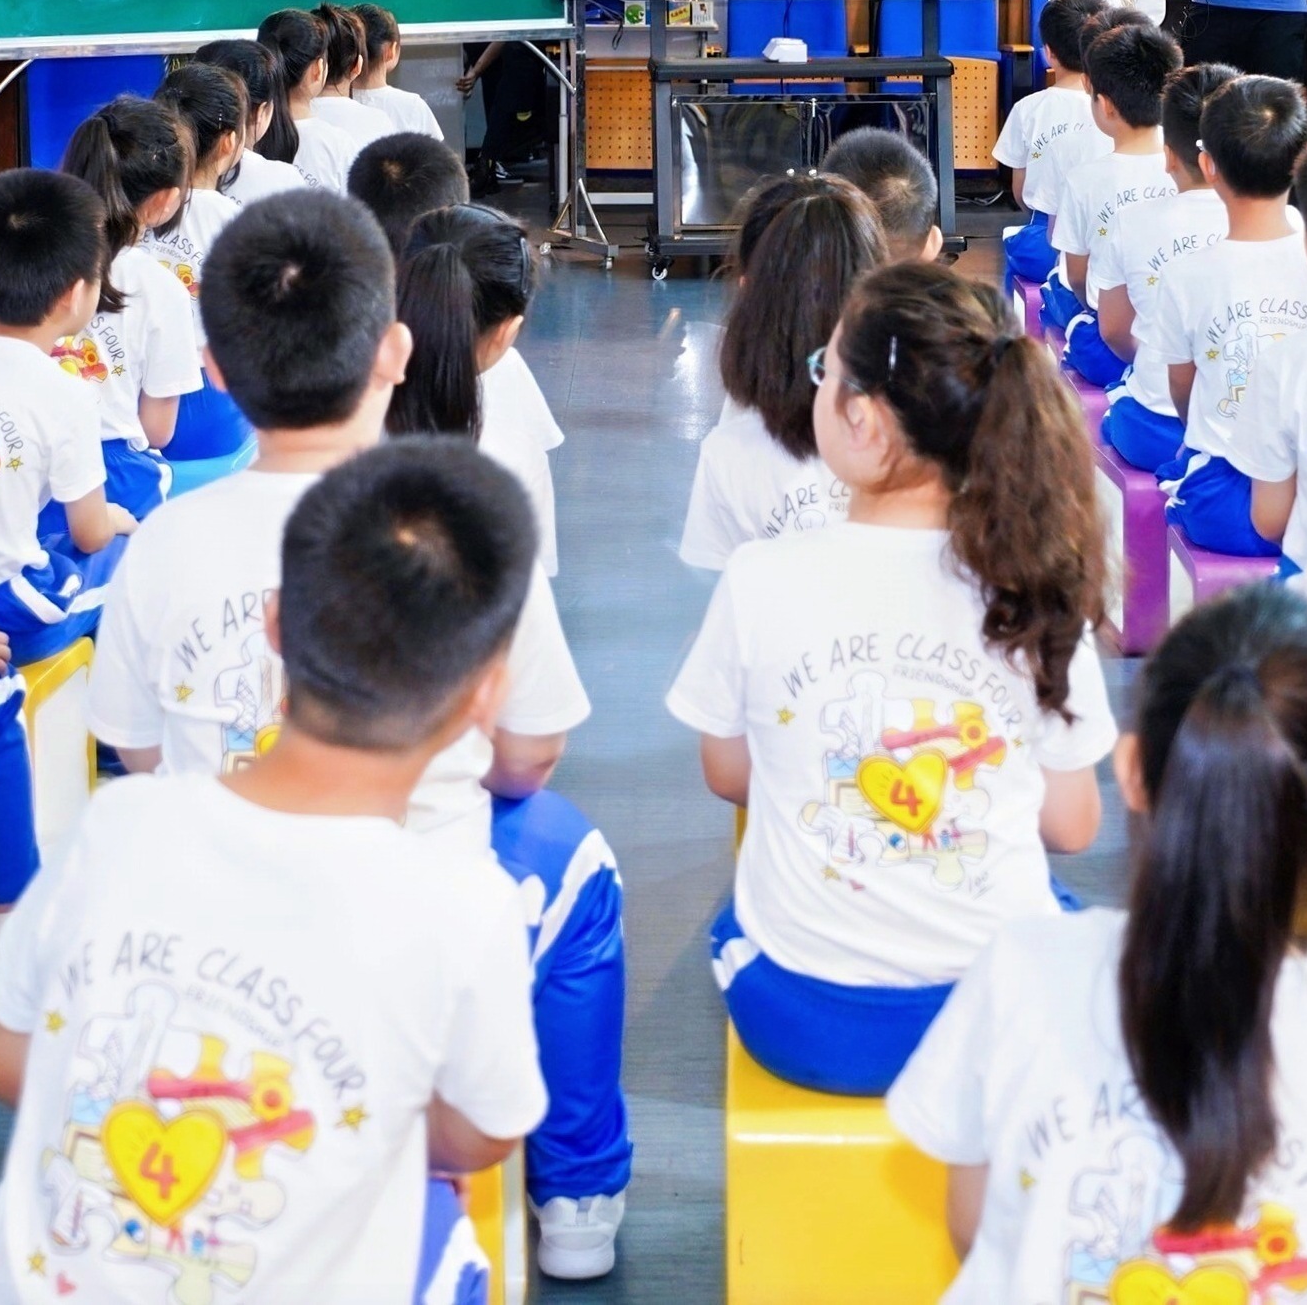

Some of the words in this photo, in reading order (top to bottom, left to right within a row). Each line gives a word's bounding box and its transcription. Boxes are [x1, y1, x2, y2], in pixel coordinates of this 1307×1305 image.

[1033, 132, 1049, 150] WE
[1097, 202, 1115, 224] WE
[1116, 188, 1138, 208] ARE
[1143, 186, 1178, 199] CLAS
[1147, 251, 1168, 272] WE
[1172, 233, 1199, 257] ARE
[98, 319, 126, 363] FOUR
[1205, 317, 1228, 345] WE
[1227, 297, 1253, 323] ARE
[781, 482, 820, 522] ARE
[173, 617, 212, 673] WE
[781, 650, 826, 701] WE
[828, 632, 881, 673] ARE
[895, 632, 980, 682] CLASS
[978, 675, 1023, 734] FOUR
[893, 665, 975, 699] FRIENDSHIP
[888, 779, 923, 819] 4
[111, 931, 182, 977] ARE
[196, 946, 304, 1027] CLASS
[294, 1017, 367, 1100] FOUR
[1024, 1095, 1078, 1160] WE
[1092, 1079, 1145, 1131] AR
[139, 1142, 180, 1201] 4
